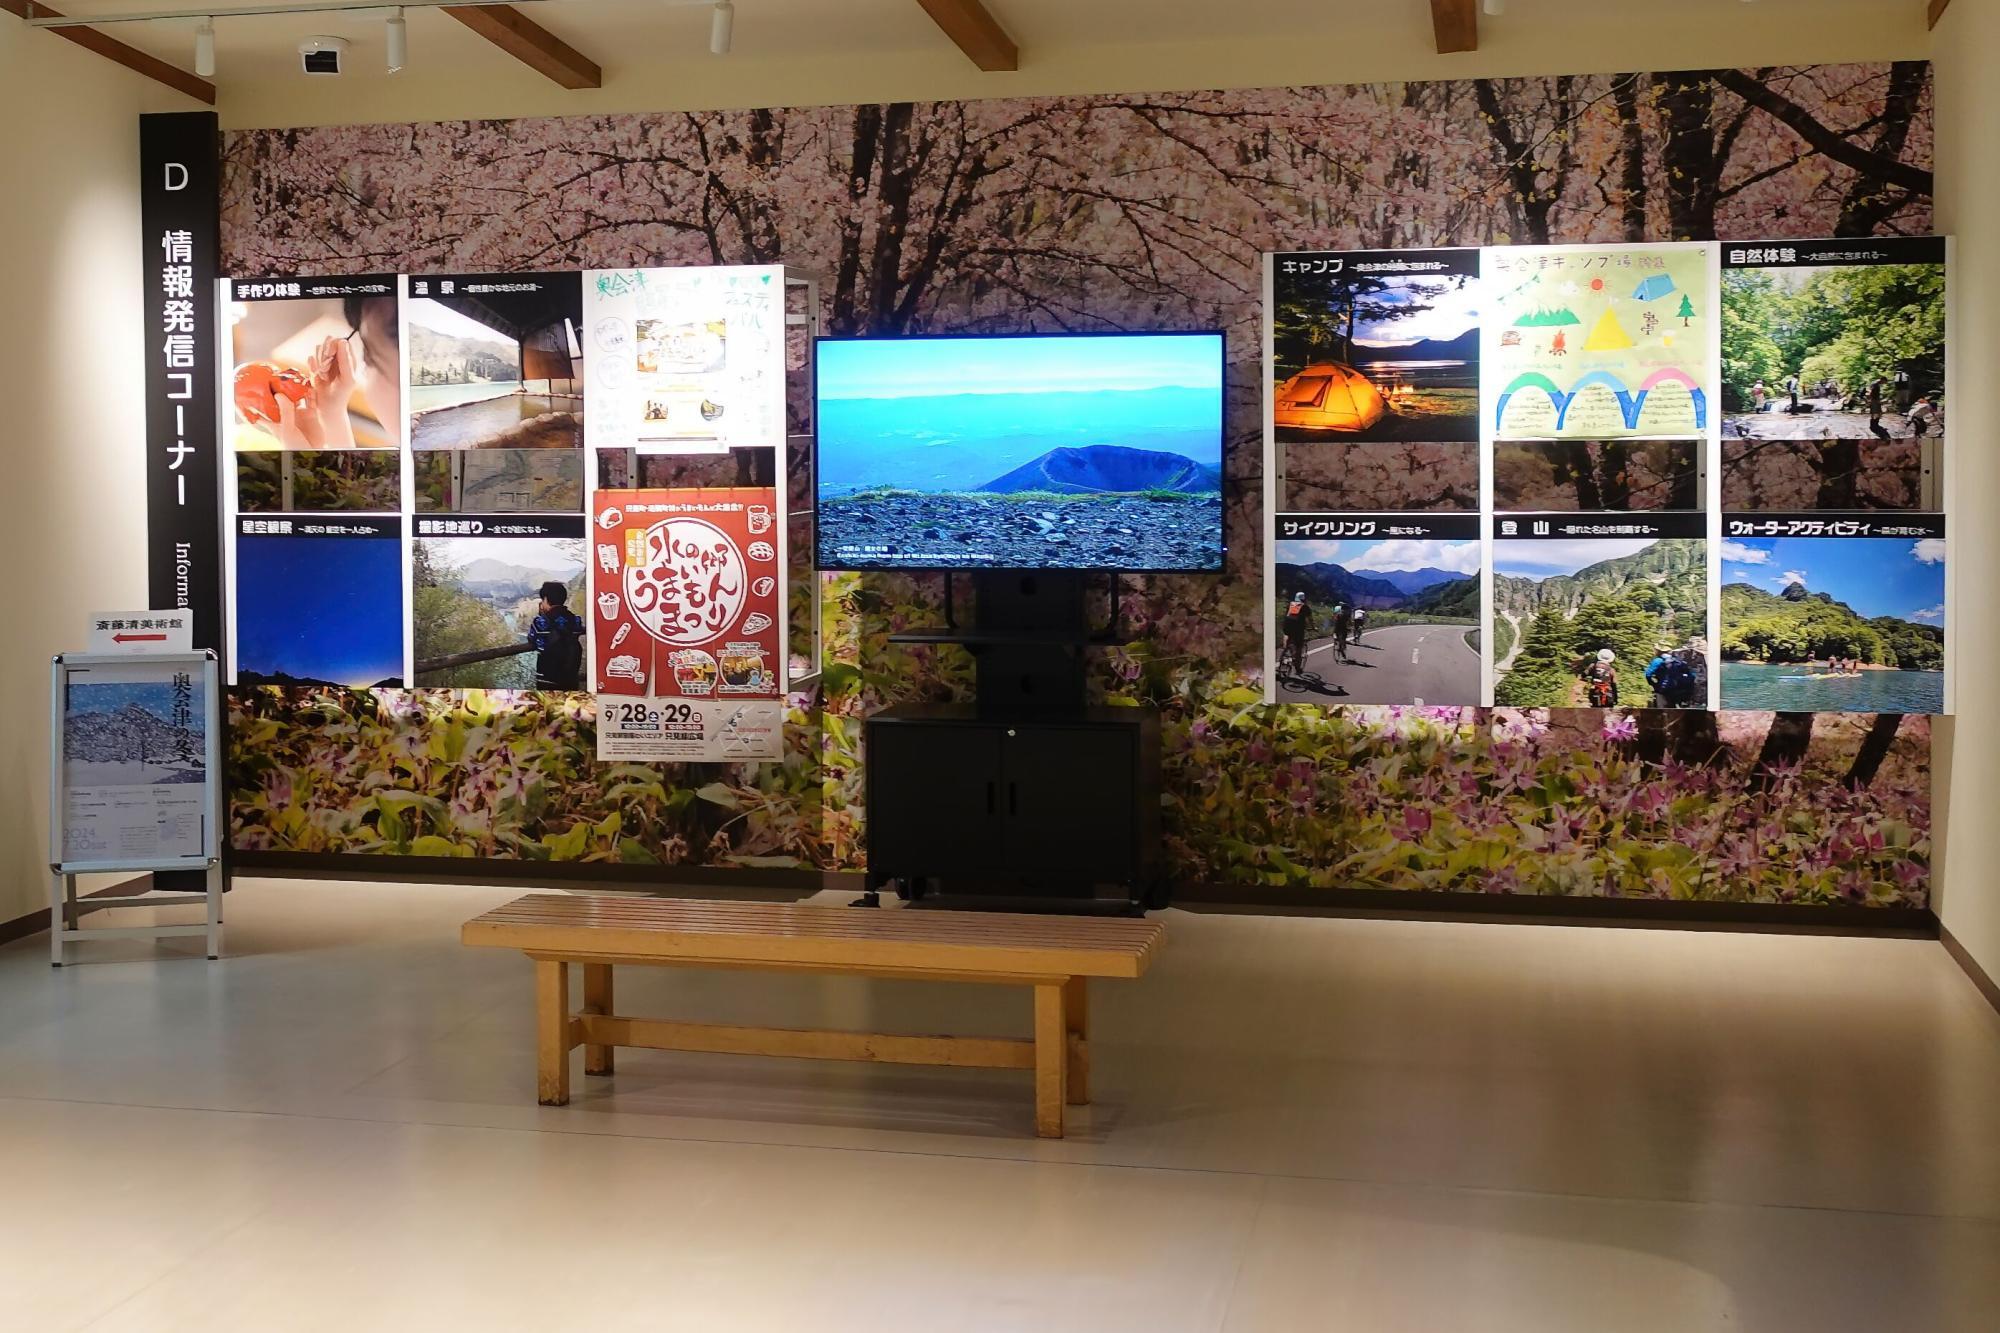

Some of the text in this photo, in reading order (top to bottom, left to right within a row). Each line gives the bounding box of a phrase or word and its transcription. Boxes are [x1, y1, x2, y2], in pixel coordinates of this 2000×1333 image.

[164, 162, 189, 191] D
[1729, 247, 1797, 264] 自然体験
[1282, 258, 1344, 274] キャンプ
[237, 282, 301, 298] 手作り体験
[161, 229, 196, 506] 情報発信コーナー
[1283, 520, 1377, 536] サイクリング
[1729, 519, 1872, 536] ウォーターアクティビティ
[95, 618, 184, 631] 斎藤清美術館
